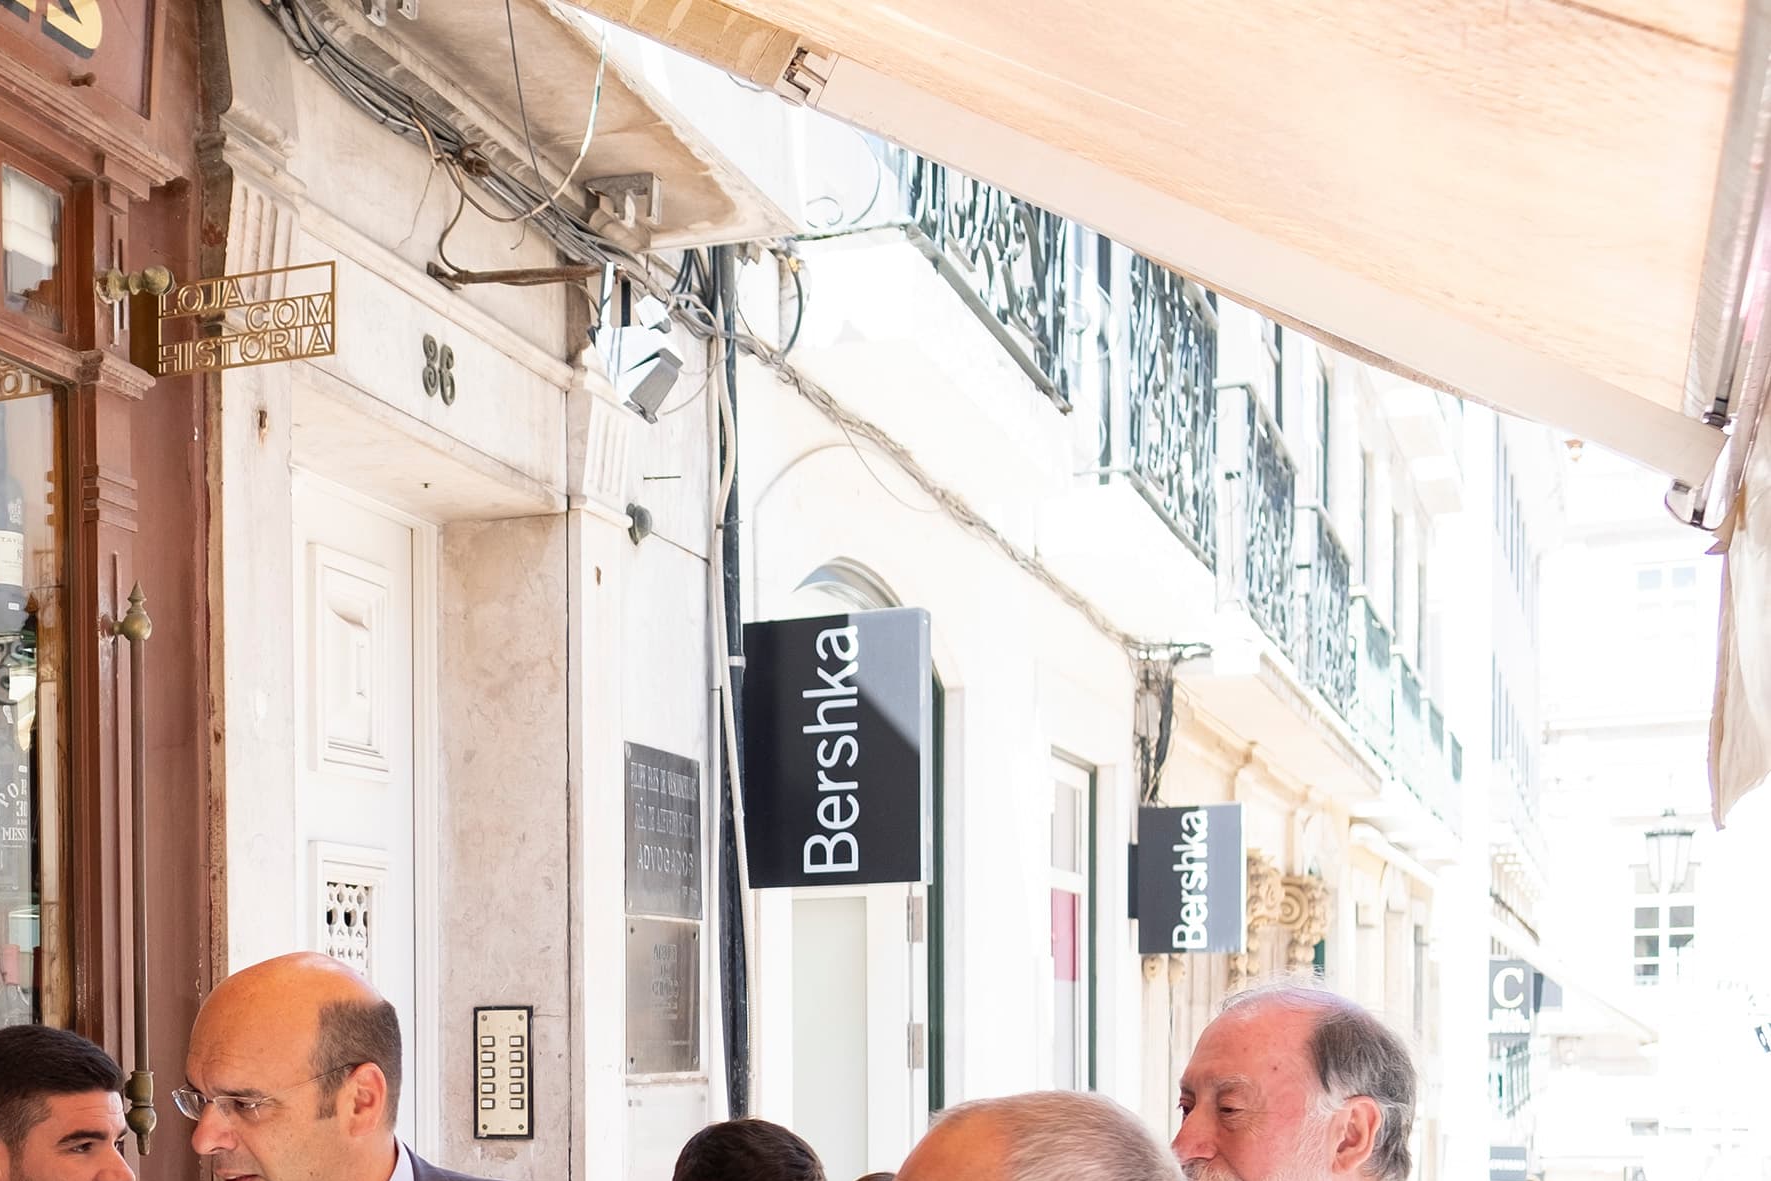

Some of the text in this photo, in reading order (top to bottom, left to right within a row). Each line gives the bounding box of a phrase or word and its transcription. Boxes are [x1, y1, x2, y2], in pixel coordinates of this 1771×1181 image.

[158, 277, 246, 317] LOJA
[246, 294, 332, 333] COM
[158, 323, 332, 375] HISTÓRIA
[802, 625, 860, 874] Bershka
[637, 845, 694, 878] ADVOGADOS
[1172, 809, 1209, 951] Bershka
[1492, 967, 1524, 1008] C
